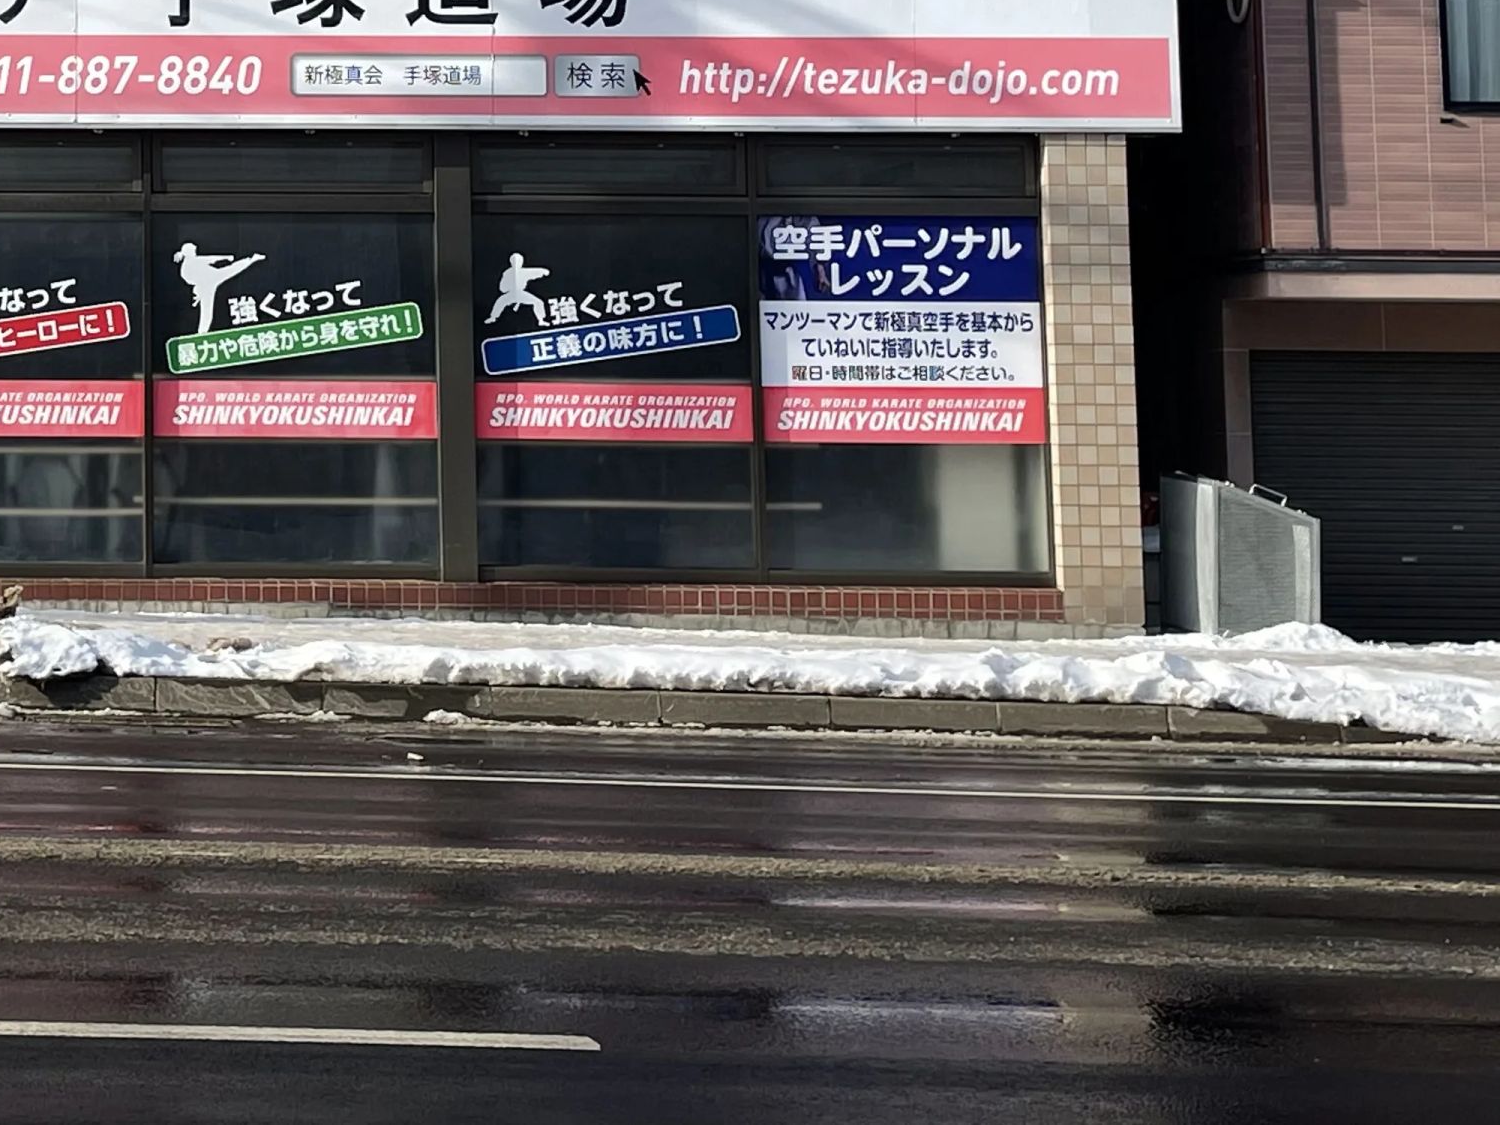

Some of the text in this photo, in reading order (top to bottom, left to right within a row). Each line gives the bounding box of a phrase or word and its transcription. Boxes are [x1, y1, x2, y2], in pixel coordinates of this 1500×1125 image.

[304, 64, 482, 86] 新極真会 手塚道場
[566, 63, 626, 90] 検索
[679, 59, 1119, 100] http://tezuka-dojo.com
[772, 225, 1022, 261] 空手パーソナル
[831, 262, 970, 296] レッスン
[228, 280, 362, 325] 強くなって
[548, 281, 684, 326] 強くなって
[763, 311, 1034, 333] マンツーマンで新極真空手を基本から
[801, 338, 998, 359] ていねいに指導いたします。
[792, 365, 1015, 382] 曜日・時間帯はご相談ください。
[27, 392, 123, 403] ORGANIZATION
[215, 393, 261, 403] WORLD
[265, 393, 315, 403] KARATE
[319, 393, 417, 404] ORGANIZATION
[534, 395, 580, 405] WORLD
[583, 395, 634, 405] KARATE
[638, 395, 736, 406] ORGANIZATION
[820, 398, 866, 408] WORLD
[871, 398, 922, 408] KARATE
[927, 399, 1026, 409] ORGANIZATION
[173, 405, 414, 426] SHINKYOKUSHINKAI
[489, 407, 733, 429] SHINKYOKUSHINKAI
[777, 410, 1023, 432] SHINKYOKUSHINKAI
